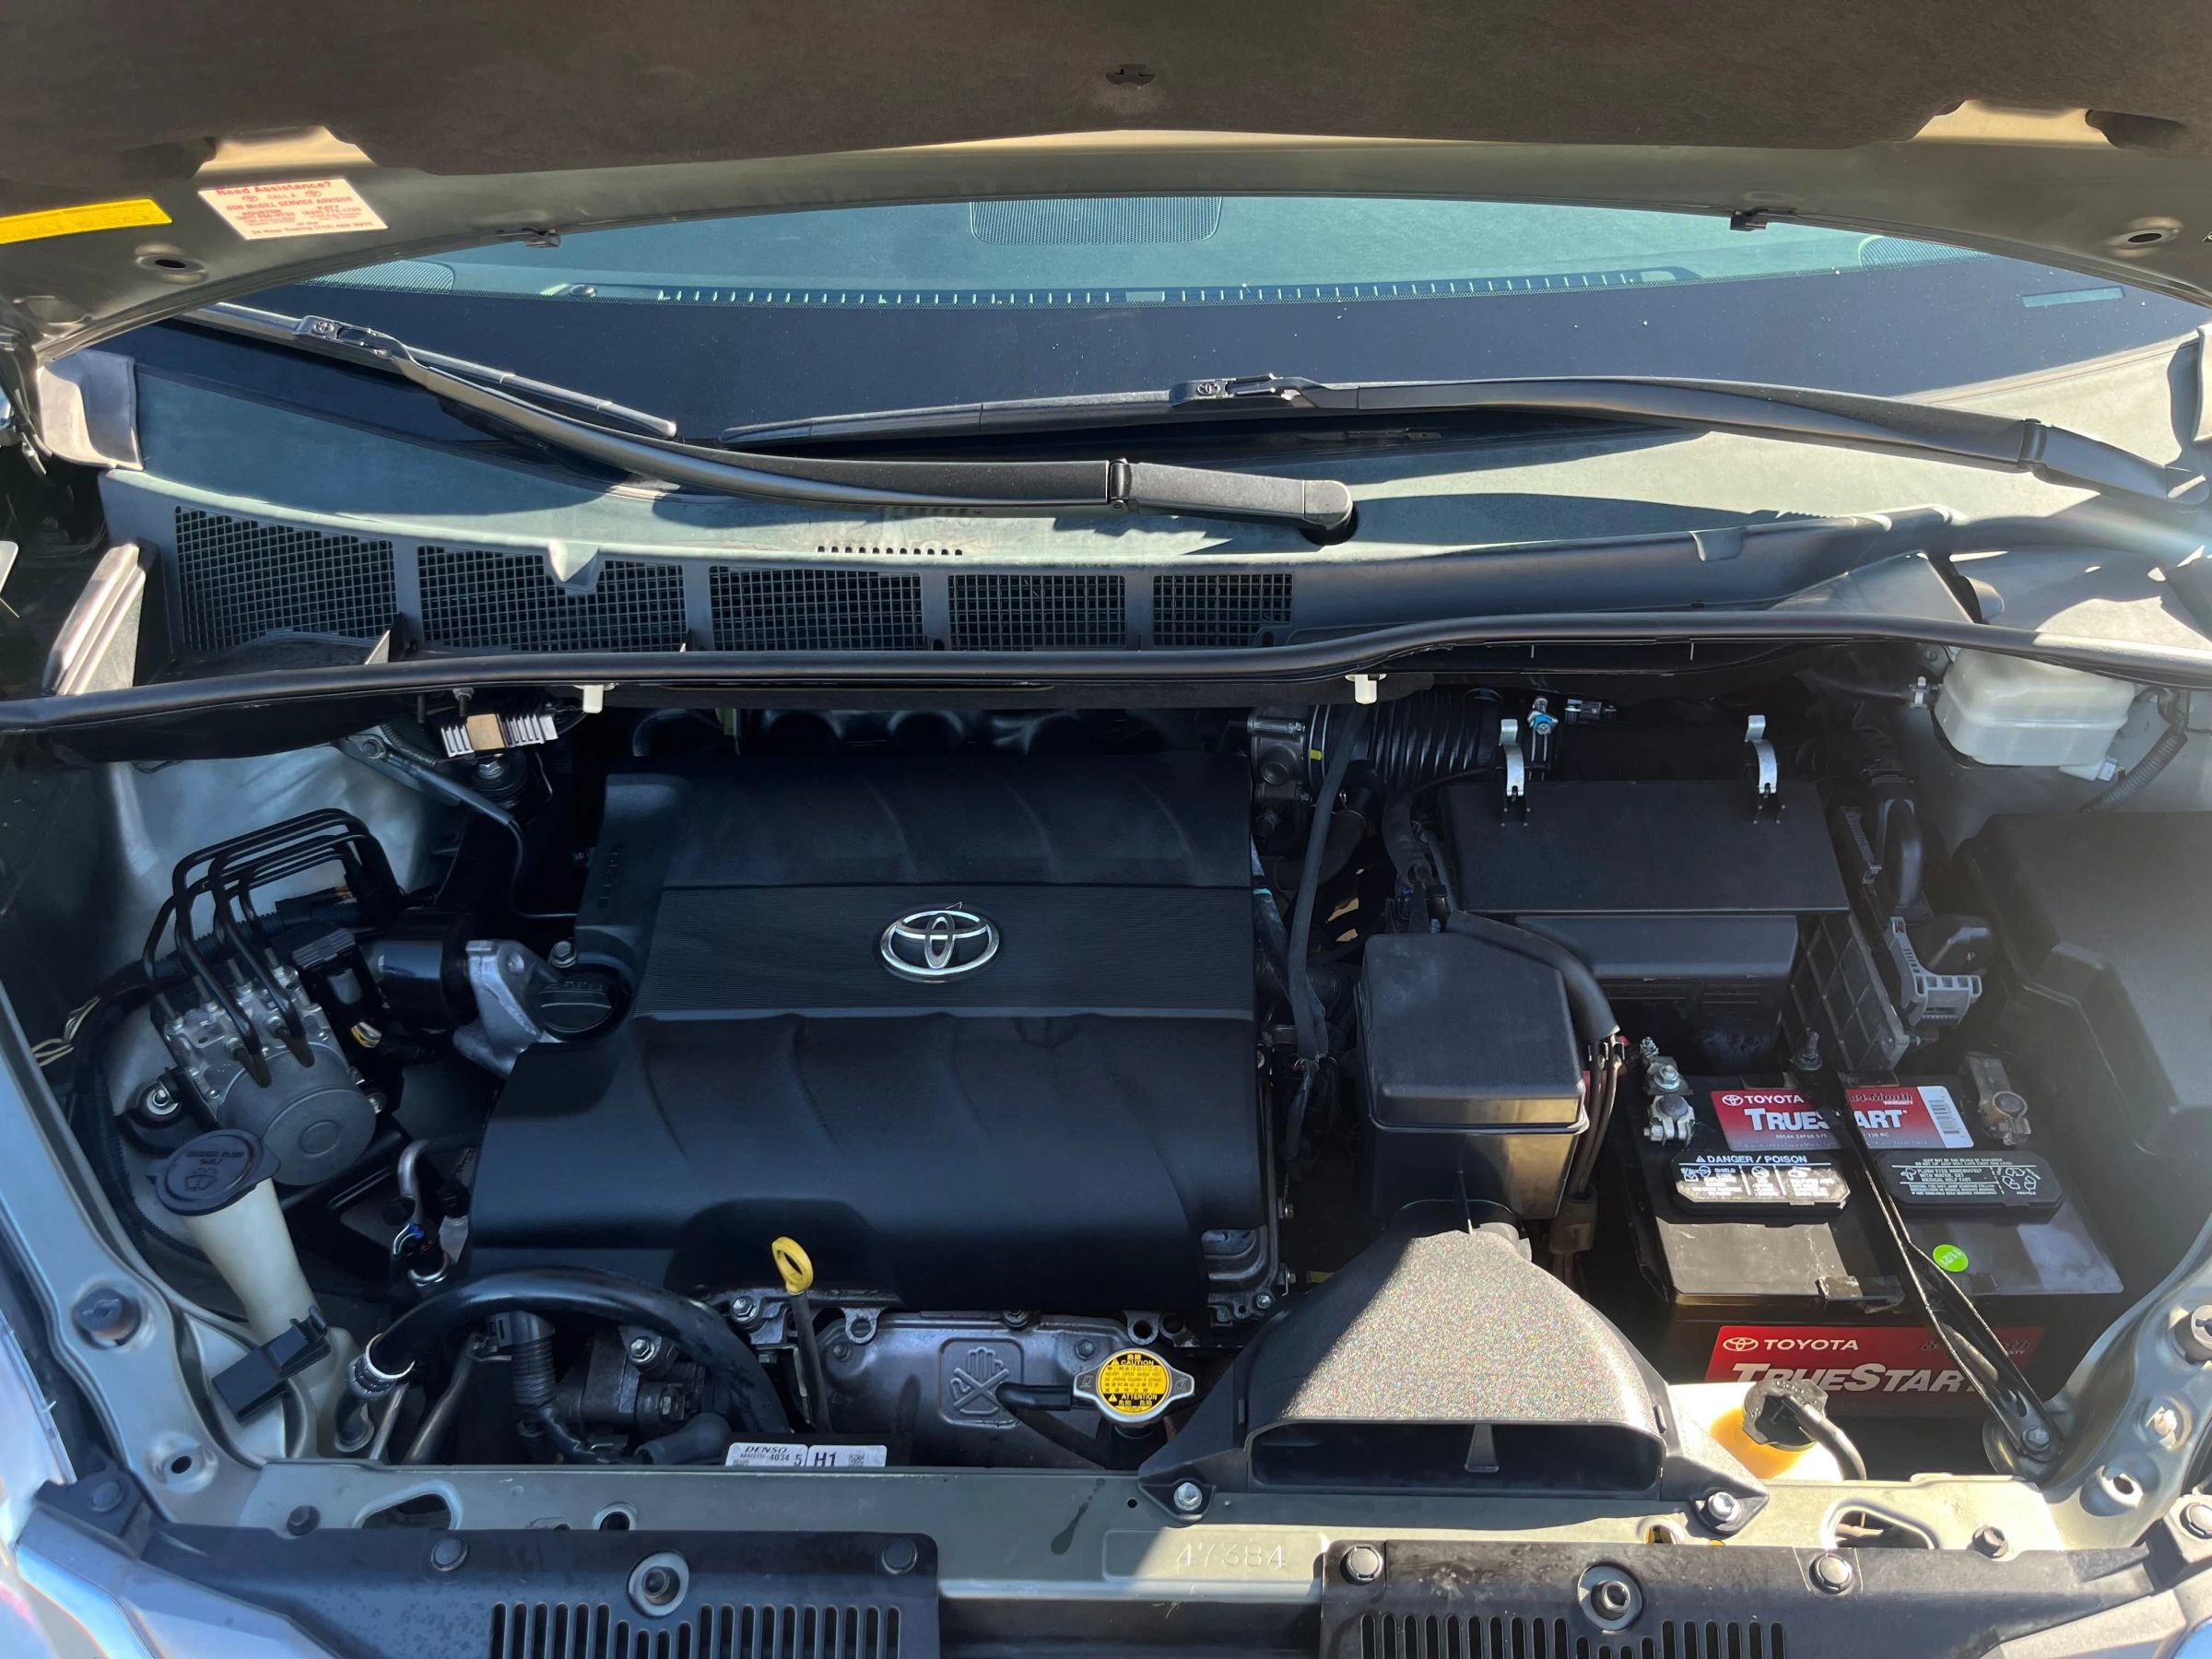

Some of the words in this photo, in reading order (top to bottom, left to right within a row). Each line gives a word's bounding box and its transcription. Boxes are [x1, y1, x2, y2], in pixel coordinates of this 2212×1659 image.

[215, 186, 252, 195] Need
[254, 181, 332, 193] Assistance?
[1744, 1094, 1805, 1104] TOYOTA
[1707, 1155, 1753, 1163] DANGER
[1755, 1155, 1761, 1163] /
[1765, 1155, 1807, 1163] POISON
[1763, 1339, 1859, 1351] TOYOTA
[745, 1445, 788, 1453] DENSO
[814, 1452, 837, 1466] H1
[1175, 1541, 1286, 1571] 47384
